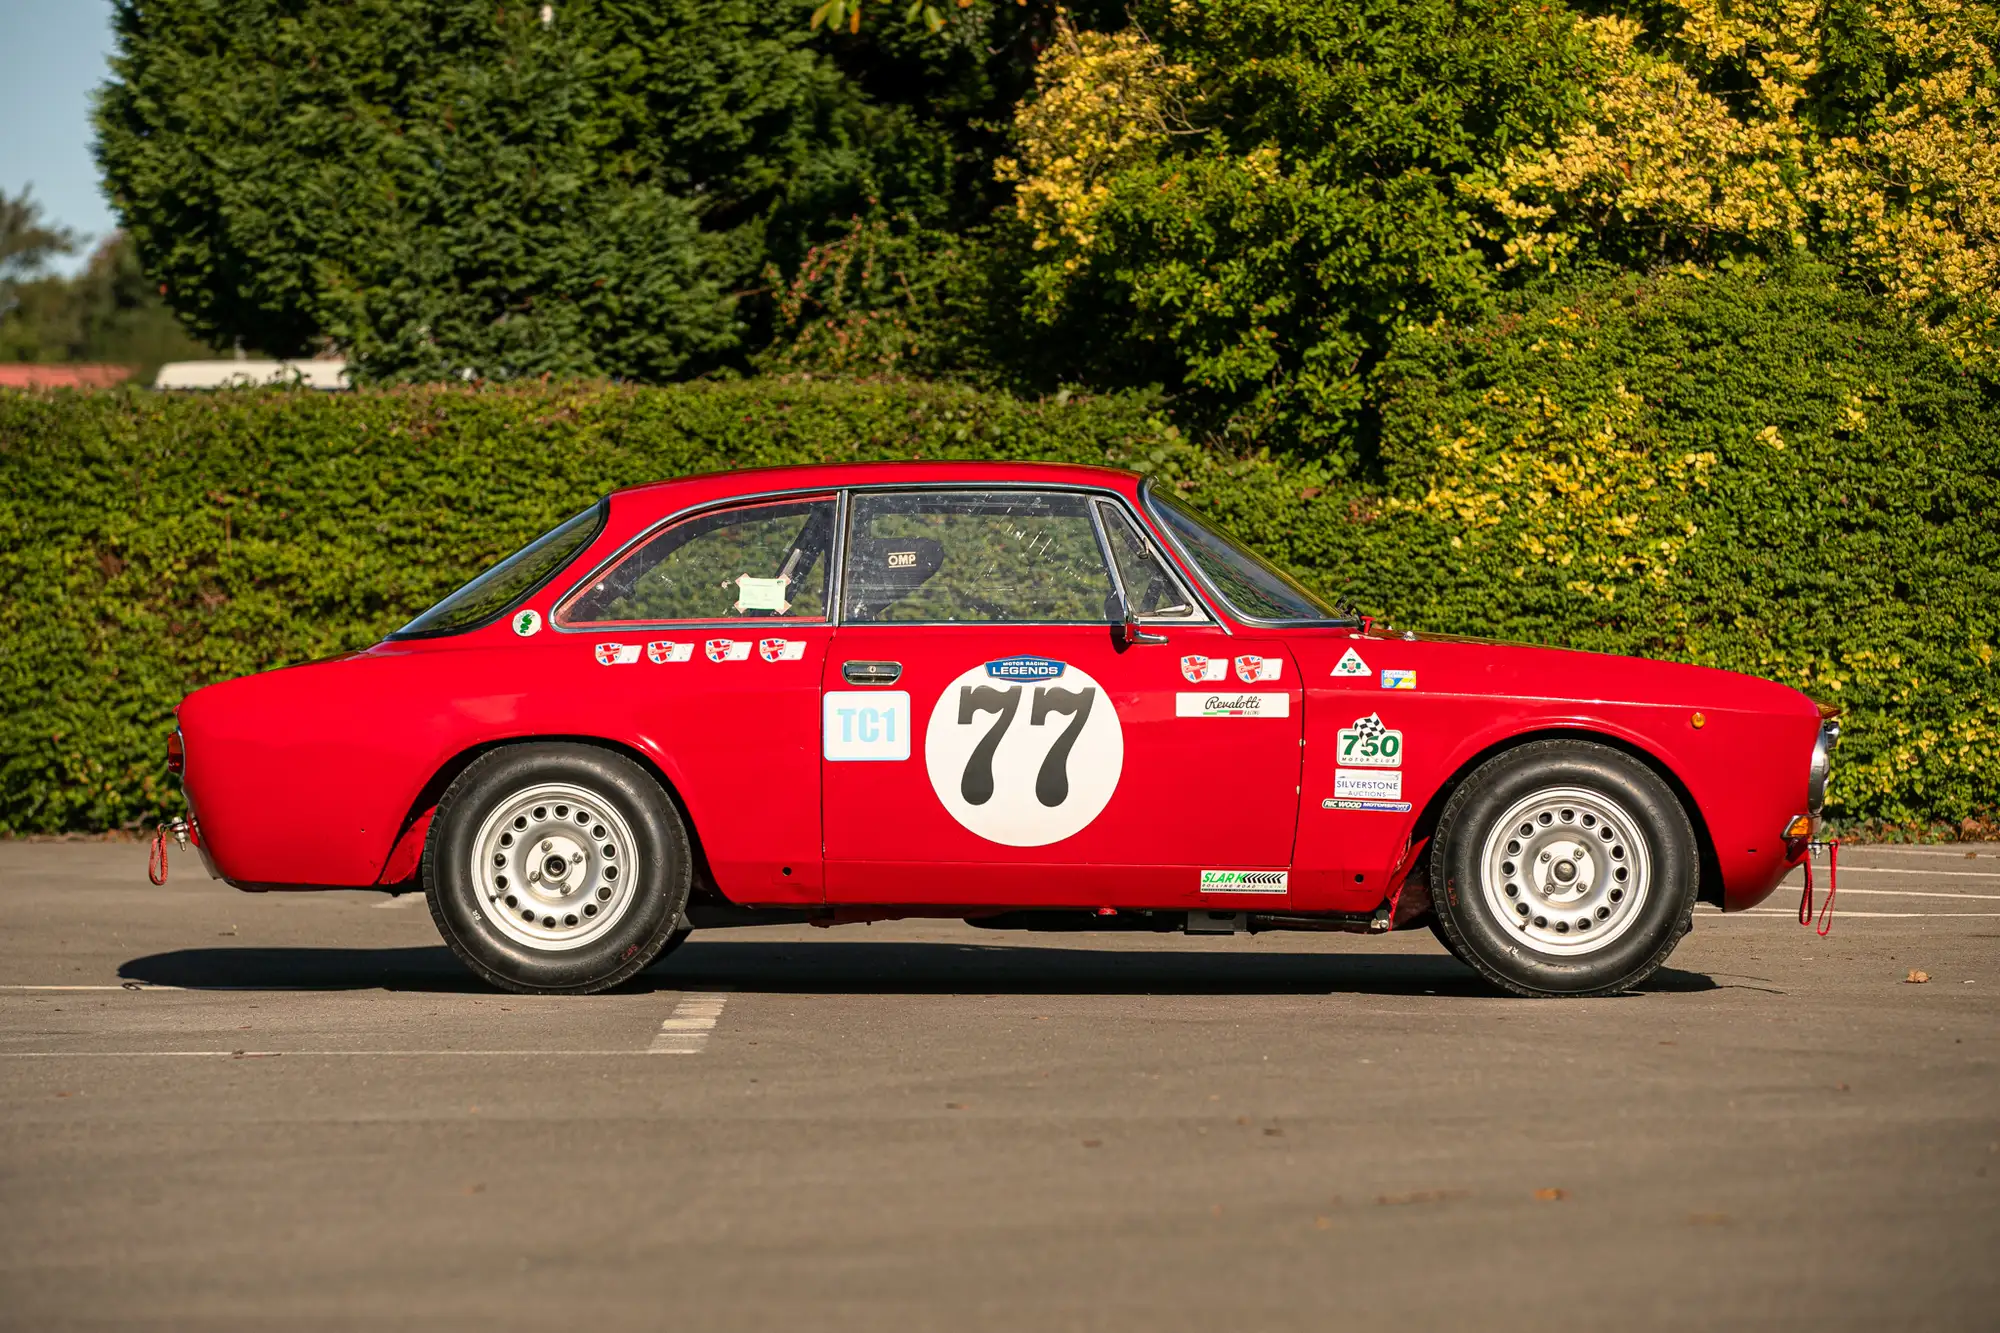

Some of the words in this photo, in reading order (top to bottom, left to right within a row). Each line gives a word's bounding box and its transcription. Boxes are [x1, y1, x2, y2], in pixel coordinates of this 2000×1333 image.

[888, 554, 916, 566] OMP
[992, 666, 1058, 675] LEGENDS
[1205, 695, 1262, 710] Revalotti
[836, 708, 896, 742] TC1
[957, 685, 1097, 808] 77
[1343, 735, 1400, 757] 750
[1336, 780, 1399, 790] SILVERSTONE
[1338, 801, 1362, 809] WOOD
